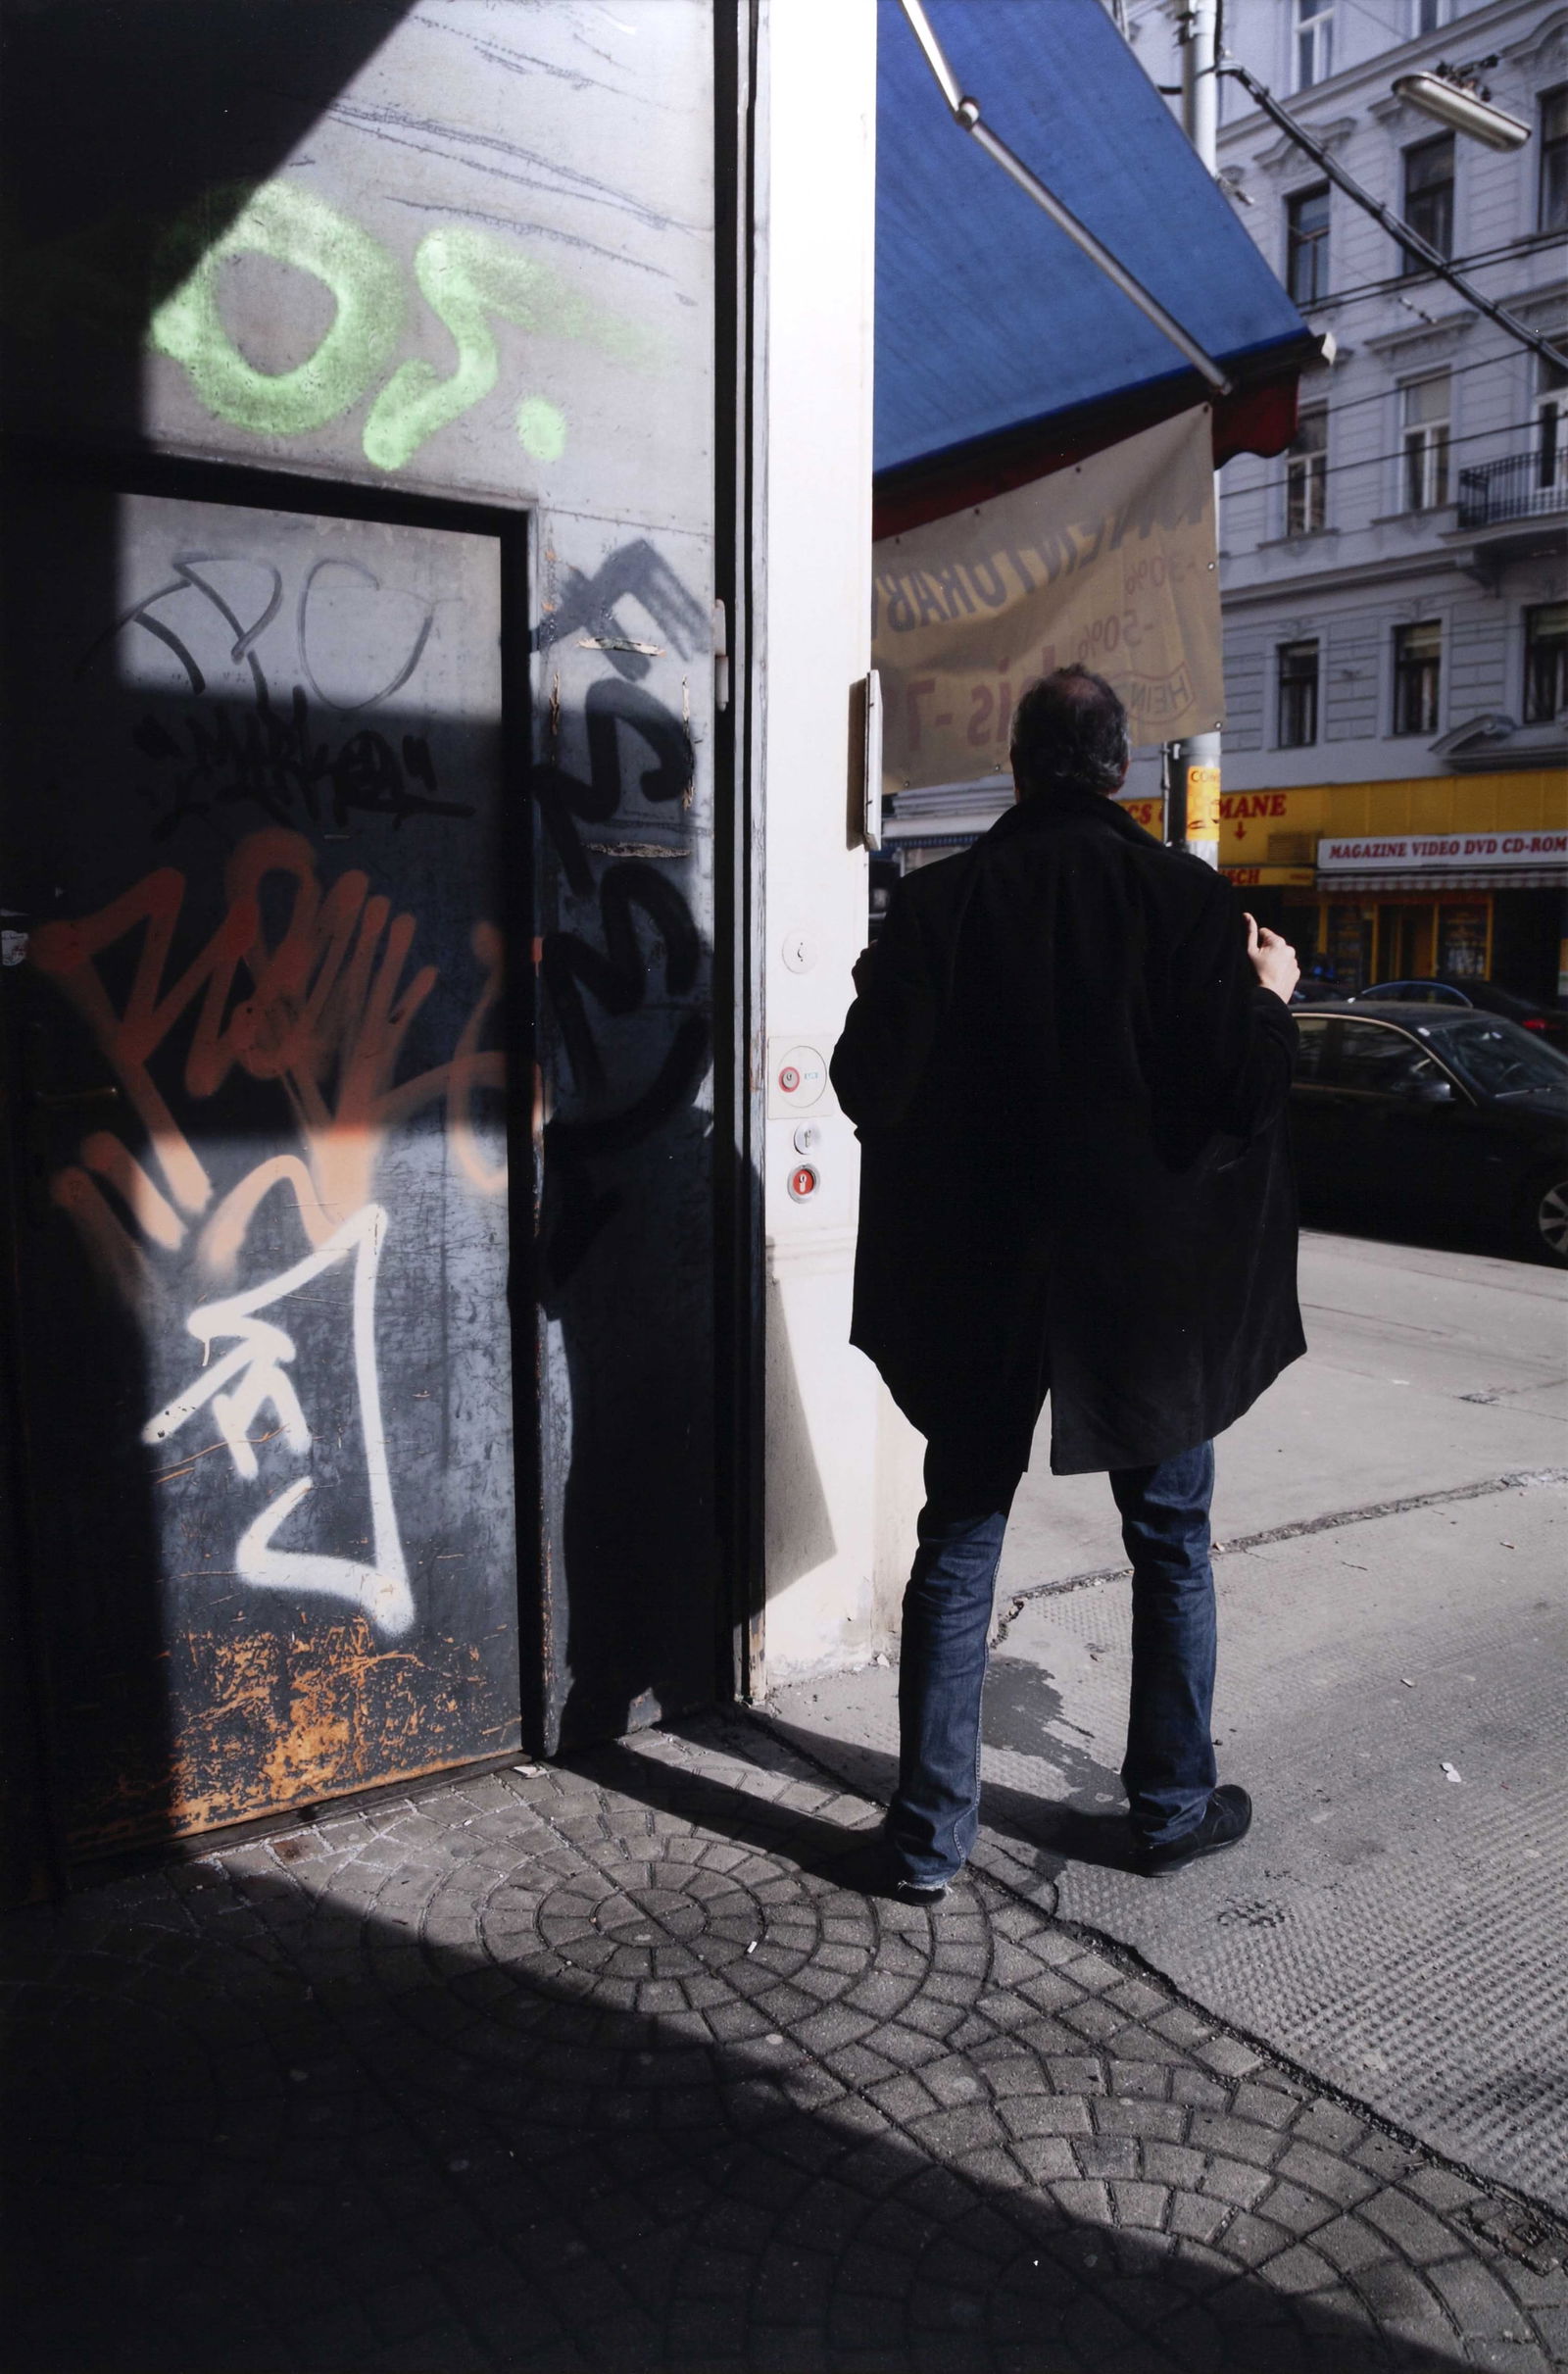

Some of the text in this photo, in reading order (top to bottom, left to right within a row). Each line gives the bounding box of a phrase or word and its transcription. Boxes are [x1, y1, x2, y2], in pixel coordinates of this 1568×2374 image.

[1219, 794, 1287, 819] MANE
[1329, 842, 1407, 860] MAGAZINE
[1411, 839, 1460, 857] VIDEO
[1464, 838, 1497, 855] DVD
